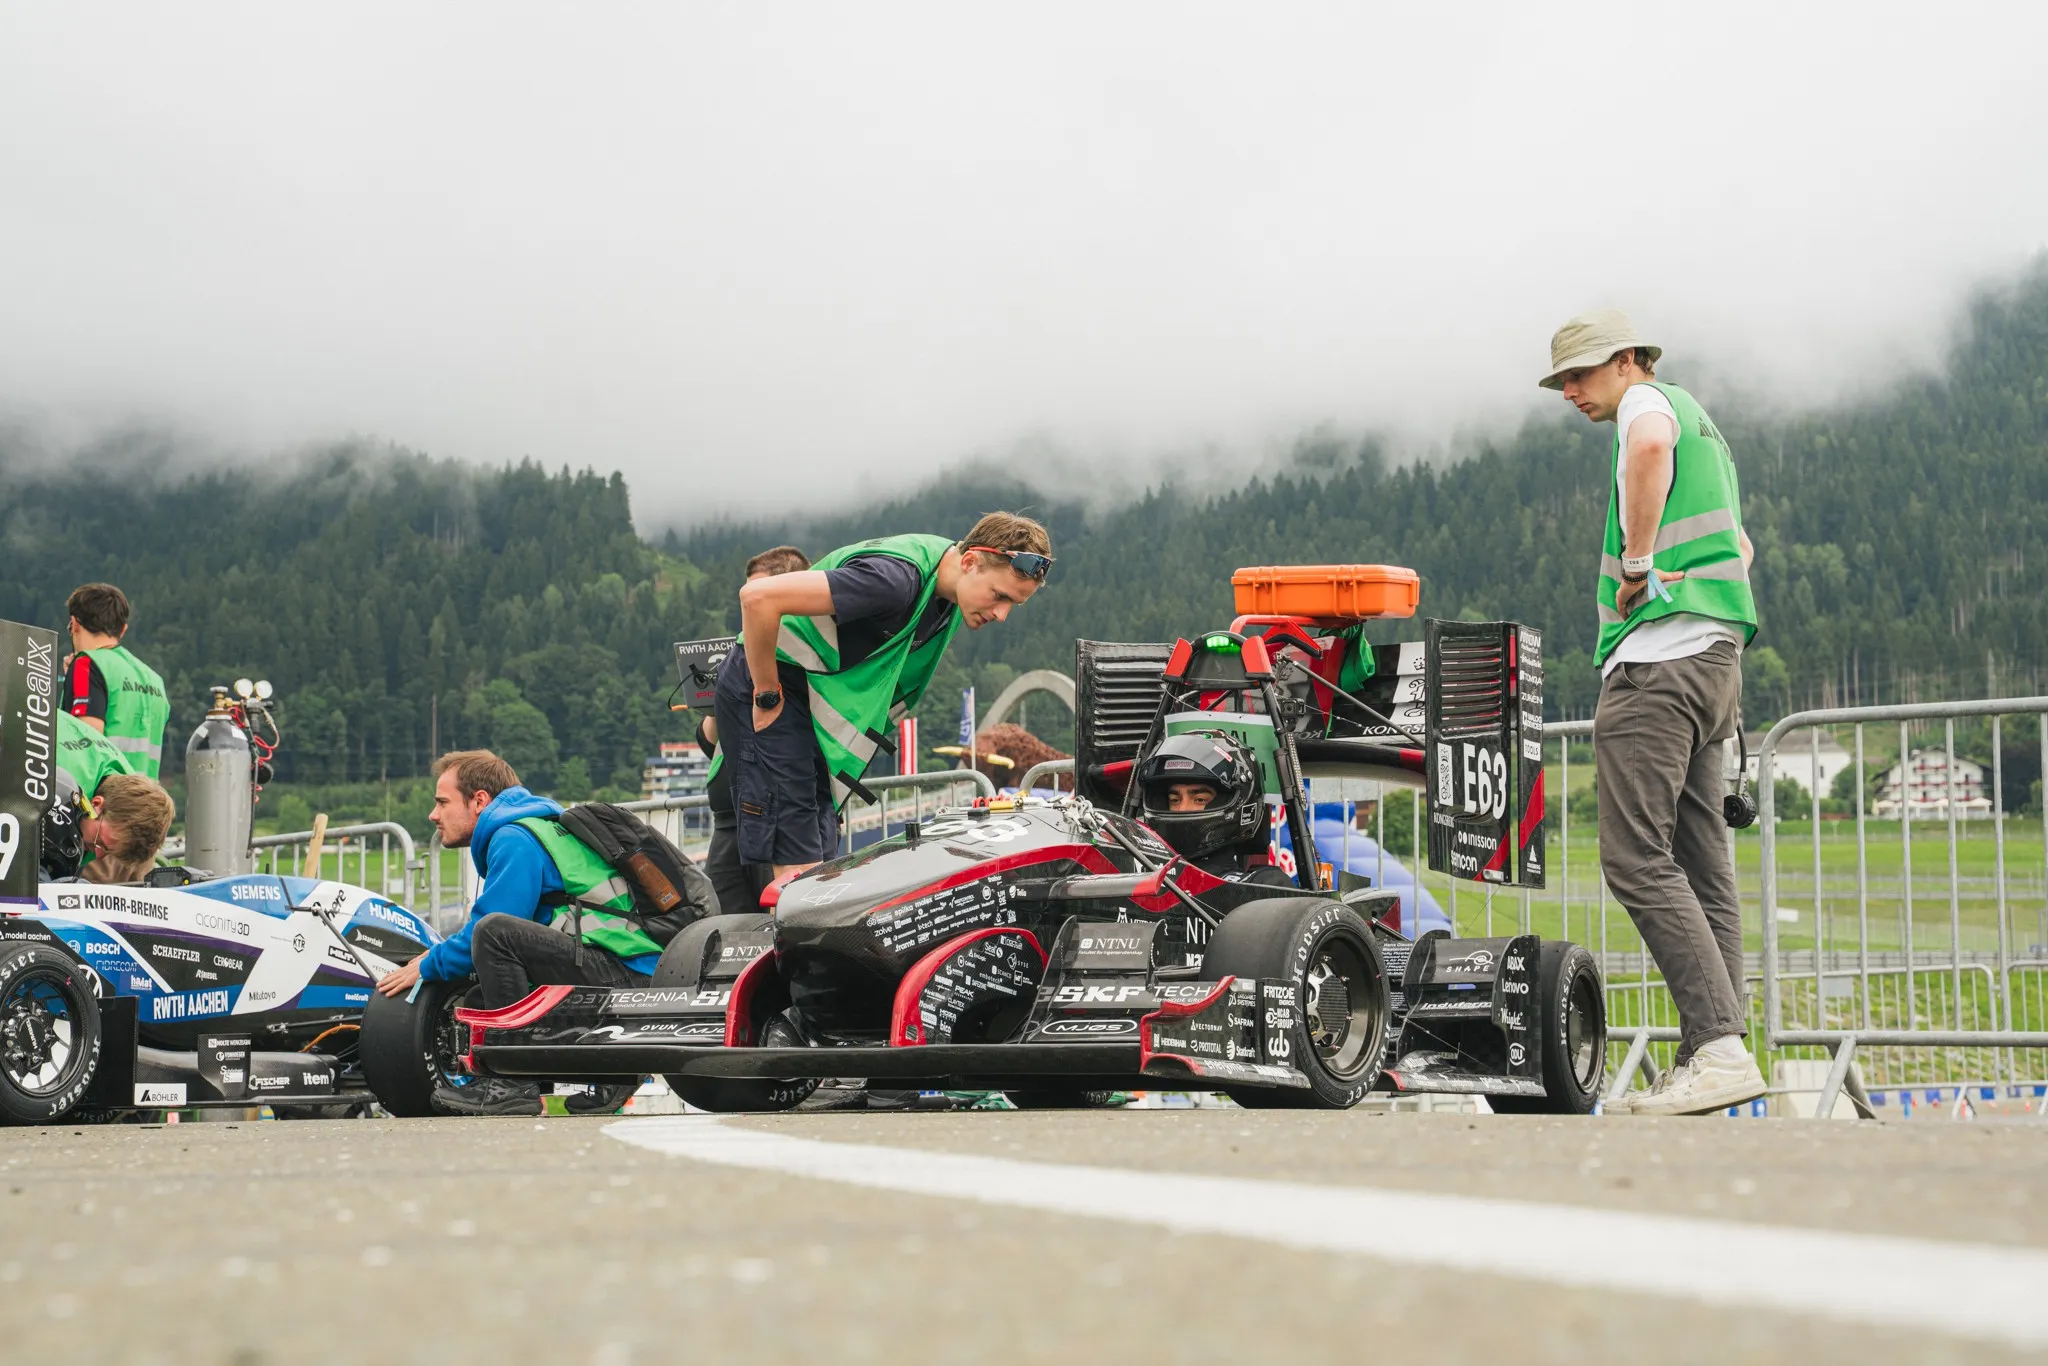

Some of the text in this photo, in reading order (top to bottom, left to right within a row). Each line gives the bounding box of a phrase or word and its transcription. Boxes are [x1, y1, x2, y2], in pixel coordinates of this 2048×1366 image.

[679, 644, 706, 655] RWTH
[17, 636, 52, 801] ecurieaix
[1463, 742, 1507, 820] E63
[231, 885, 281, 900] SIEMENS
[84, 894, 169, 921] KNORR-BREMSE
[369, 902, 420, 936] HUMBEL
[27, 933, 51, 941] aachen
[292, 938, 305, 949] KTR
[1095, 938, 1141, 949] NTNU
[86, 942, 120, 955] BOSCH
[152, 944, 200, 962] SCHAEFFLER
[735, 945, 774, 957] NTN
[1445, 965, 1490, 973] SHAPE
[1506, 956, 1526, 972] ABAX
[955, 985, 974, 998] PEAK
[1501, 977, 1530, 995] Lenovo
[248, 991, 276, 1002] Mitutoyo
[610, 991, 688, 1003] TECHNIA
[1053, 985, 1147, 1002] SKF
[153, 990, 229, 1020] RWTH AACHEN
[1234, 1017, 1254, 1029] SAFRAN
[1277, 1018, 1294, 1029] GROUP
[1198, 1041, 1222, 1053] PROTOTAL
[1236, 1045, 1256, 1058] Statkraft
[256, 1076, 290, 1086] FISCHER
[303, 1072, 329, 1085] item
[151, 1091, 179, 1102] BÖHLER
